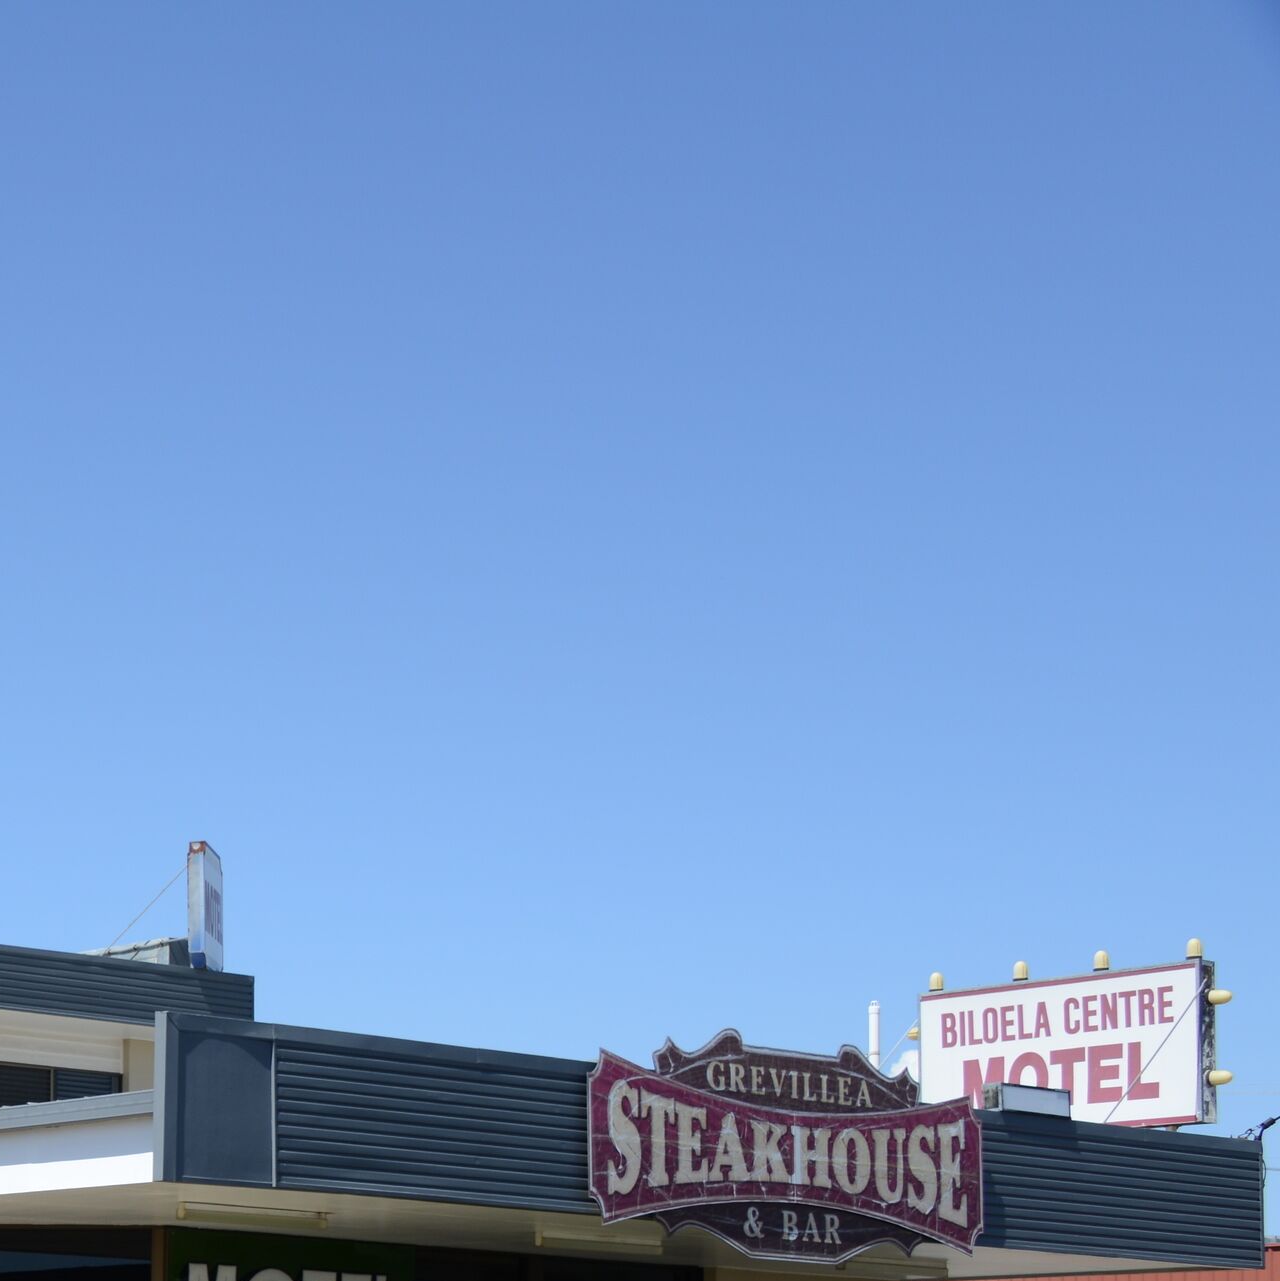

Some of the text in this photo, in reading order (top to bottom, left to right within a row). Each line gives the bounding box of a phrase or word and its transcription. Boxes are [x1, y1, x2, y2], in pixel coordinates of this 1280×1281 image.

[940, 985, 1174, 1049] BILOELA CENTRE
[705, 1060, 873, 1109] GREVILLEA
[962, 1041, 1160, 1109] MOTEL
[606, 1078, 969, 1229] STEAKHOUSE
[742, 1206, 842, 1245] & BAR
